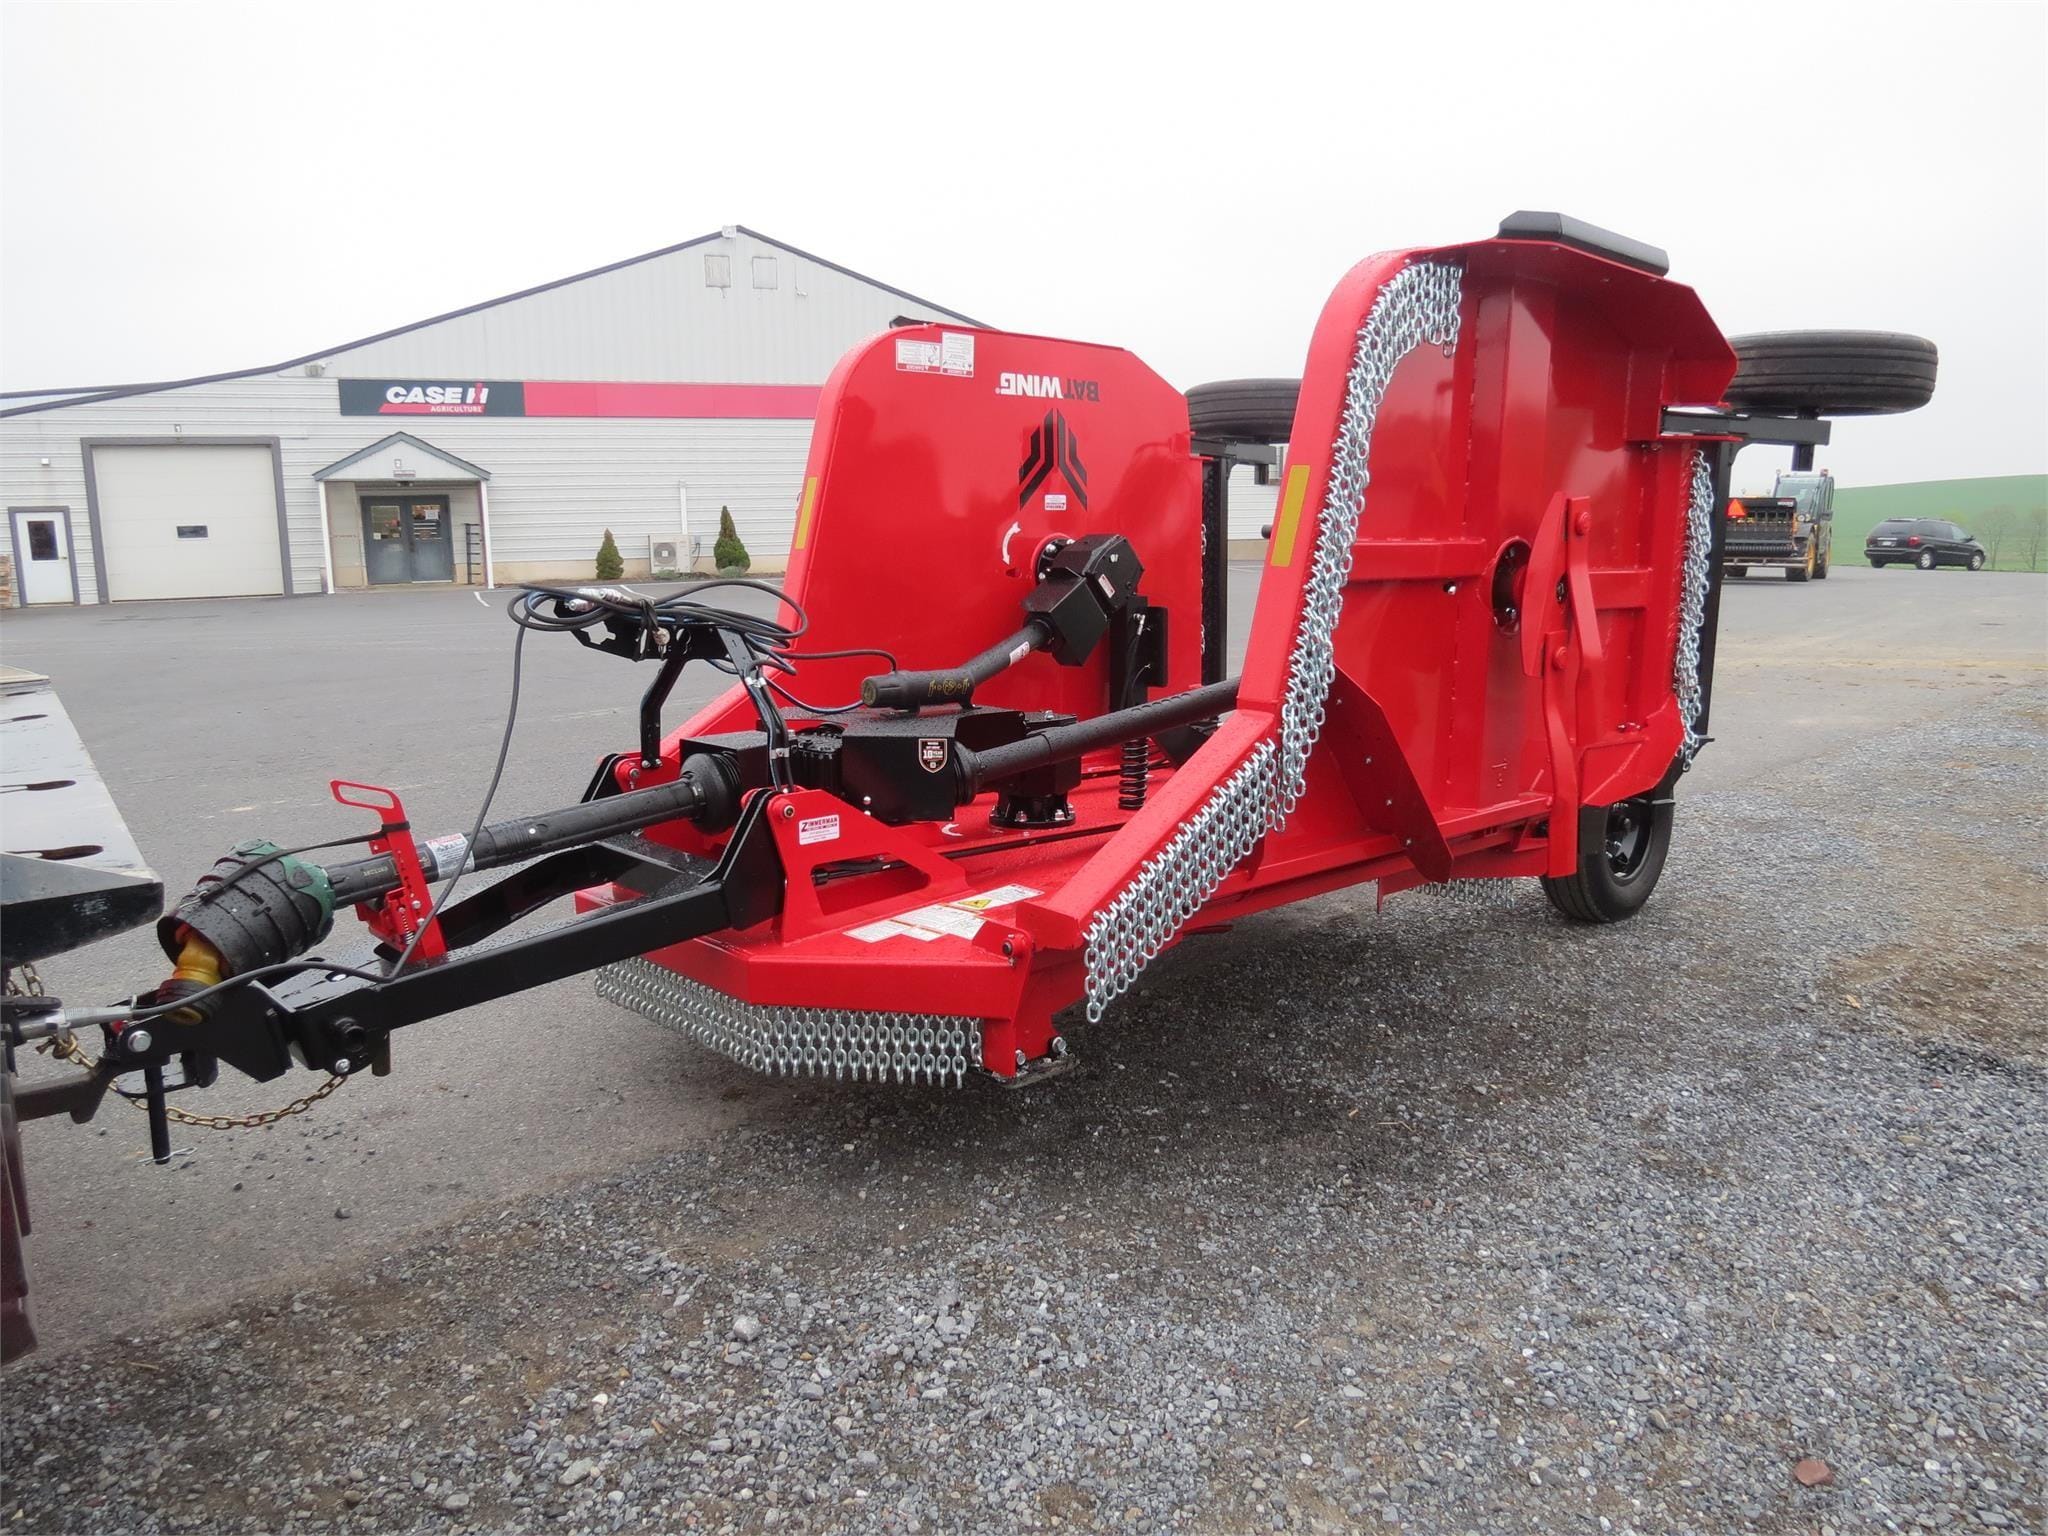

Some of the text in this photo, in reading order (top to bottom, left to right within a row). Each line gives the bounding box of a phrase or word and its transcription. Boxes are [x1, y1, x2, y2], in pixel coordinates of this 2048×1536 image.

[386, 382, 489, 404] CASE IH
[430, 405, 483, 413] AGRICULTURE
[801, 817, 838, 833] ZIMMERMAN
